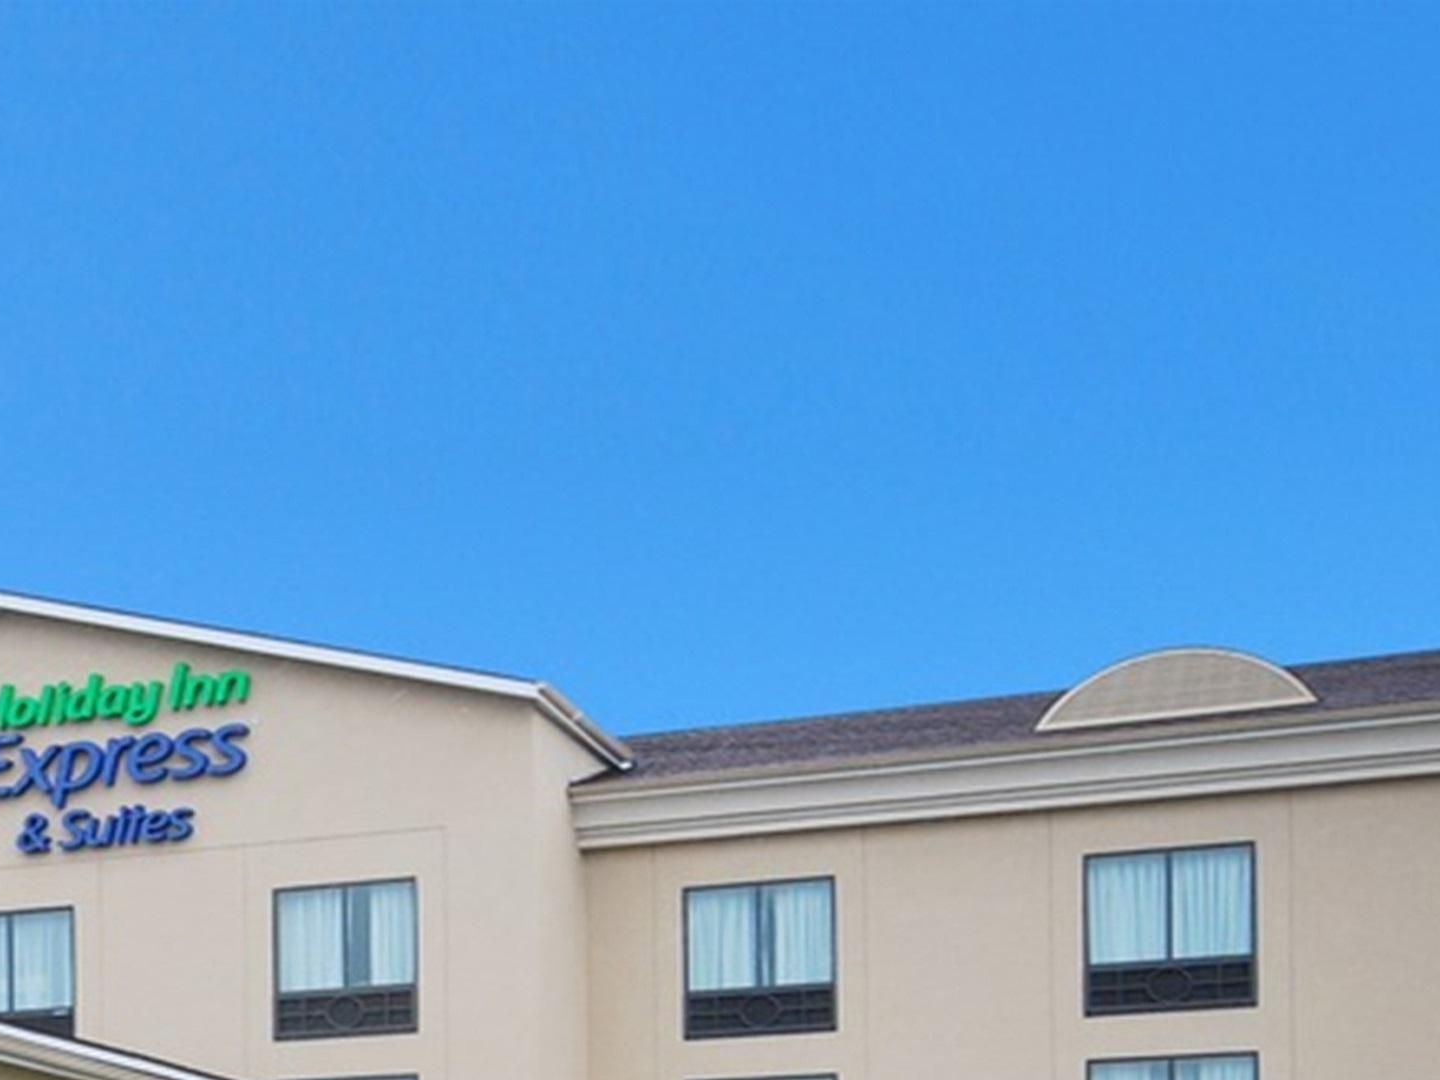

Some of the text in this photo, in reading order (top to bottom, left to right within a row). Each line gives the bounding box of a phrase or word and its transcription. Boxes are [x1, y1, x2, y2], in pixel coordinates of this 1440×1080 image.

[168, 661, 251, 710] Inn
[17, 804, 195, 853] & Suites
